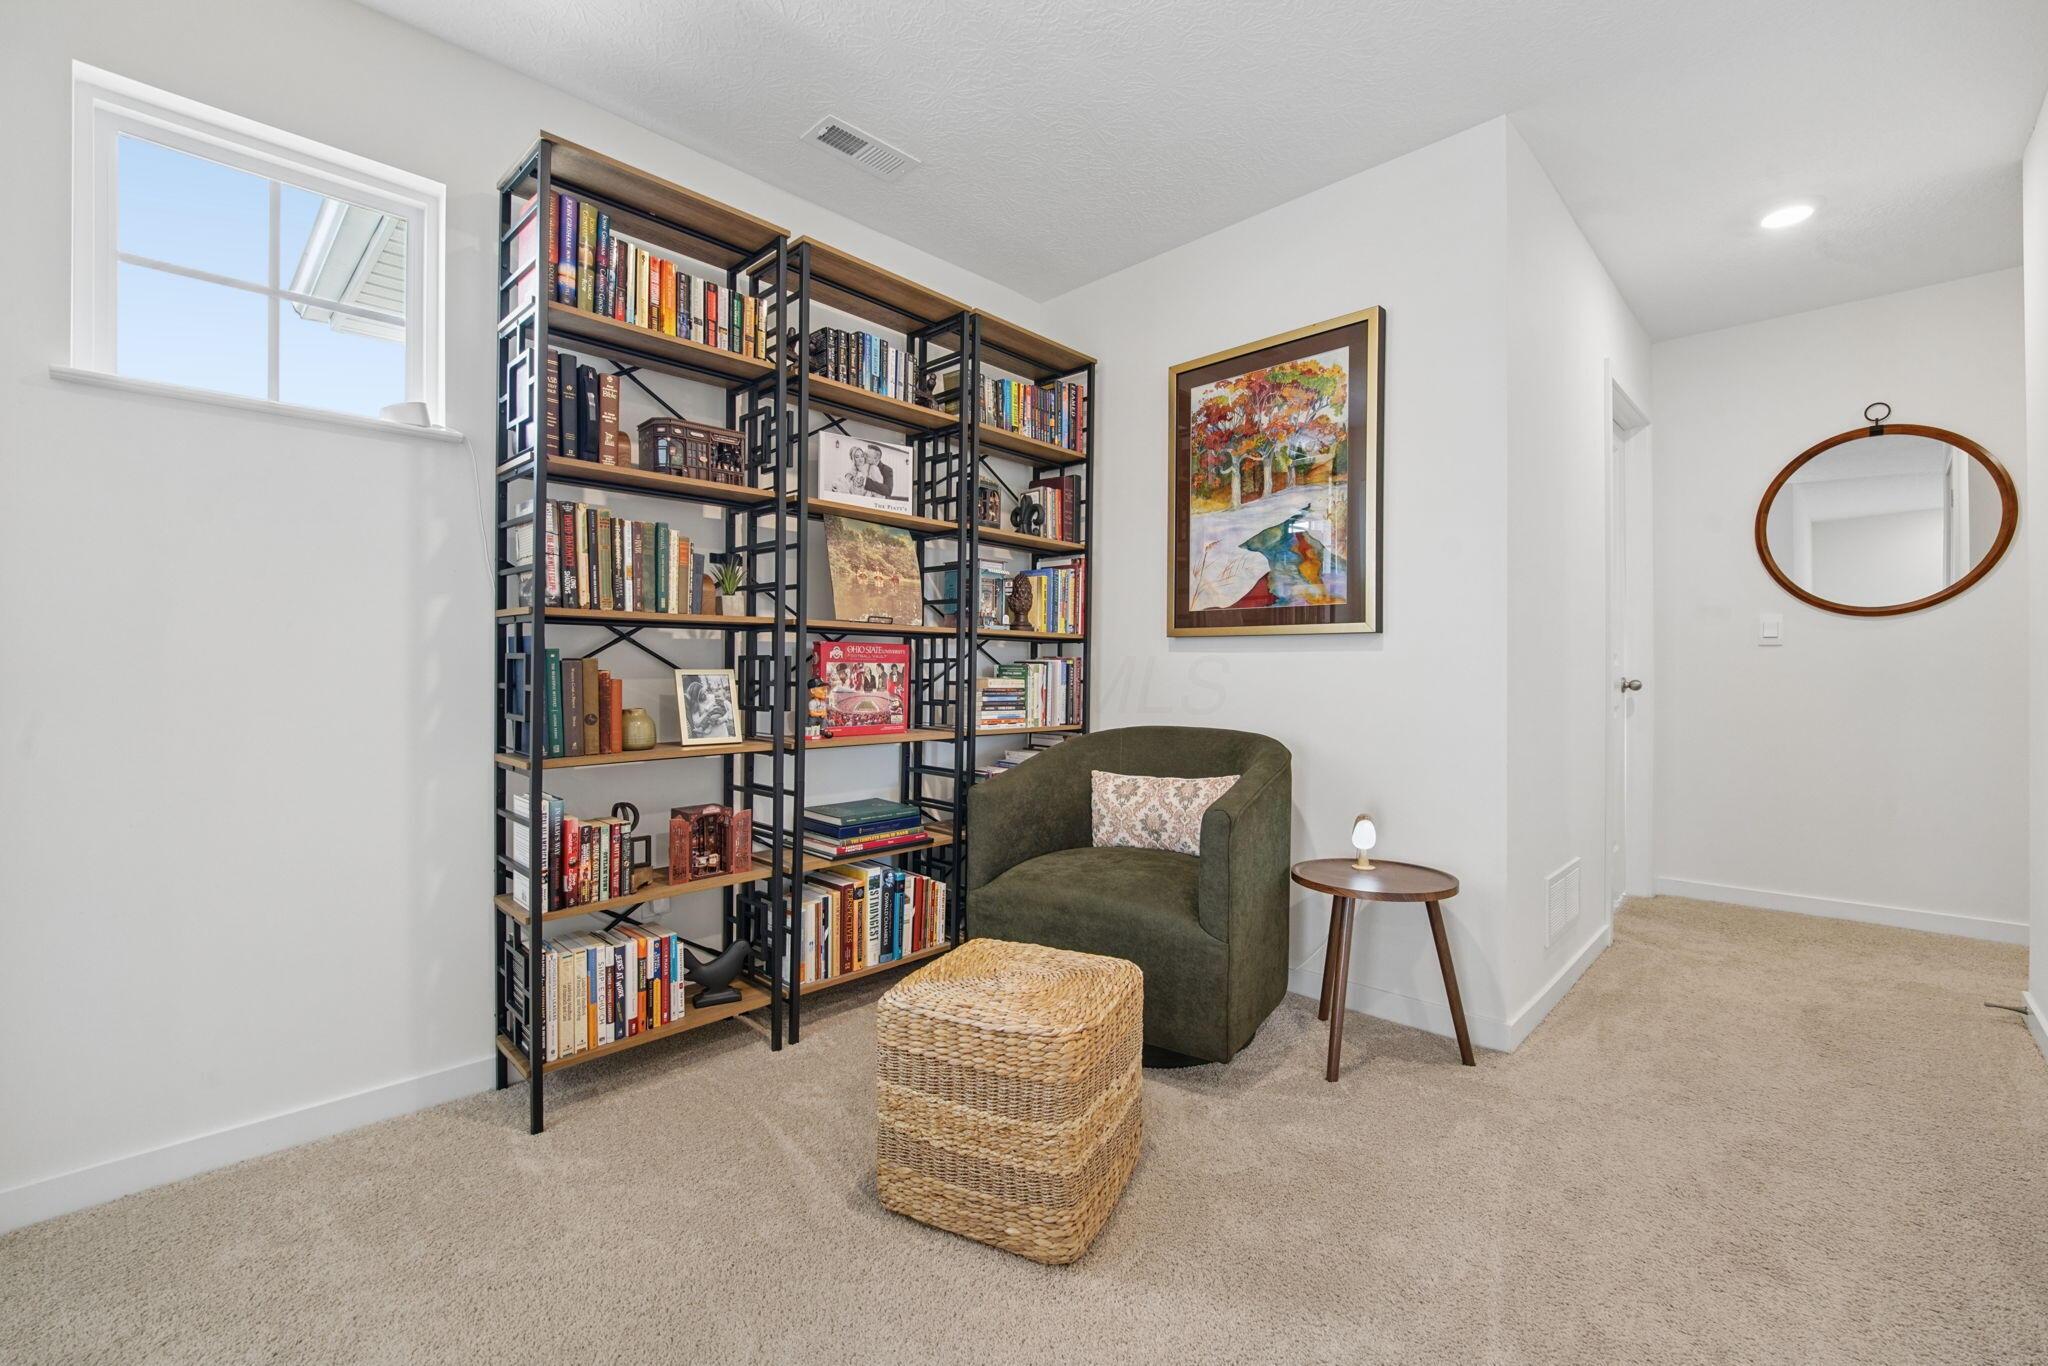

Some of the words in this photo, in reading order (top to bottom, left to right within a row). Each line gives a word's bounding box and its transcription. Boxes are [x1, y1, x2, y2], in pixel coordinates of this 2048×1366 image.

[600, 230, 608, 256] GRISHAM
[602, 390, 617, 401] Bible
[563, 514, 574, 535] DAVID
[564, 535, 575, 567] BALDACCI
[549, 573, 557, 592] ESCAPE
[563, 570, 571, 595] SHADOWS
[569, 575, 577, 589] LONG
[846, 645, 865, 654] OHIO
[865, 645, 882, 654] STATE
[554, 807, 561, 816] IN
[846, 887, 854, 944] PERSPECTIVES
[869, 890, 879, 942] STRONGEST
[614, 954, 624, 971] JERKS
[616, 972, 624, 980] AT
[616, 980, 624, 999] WORK
